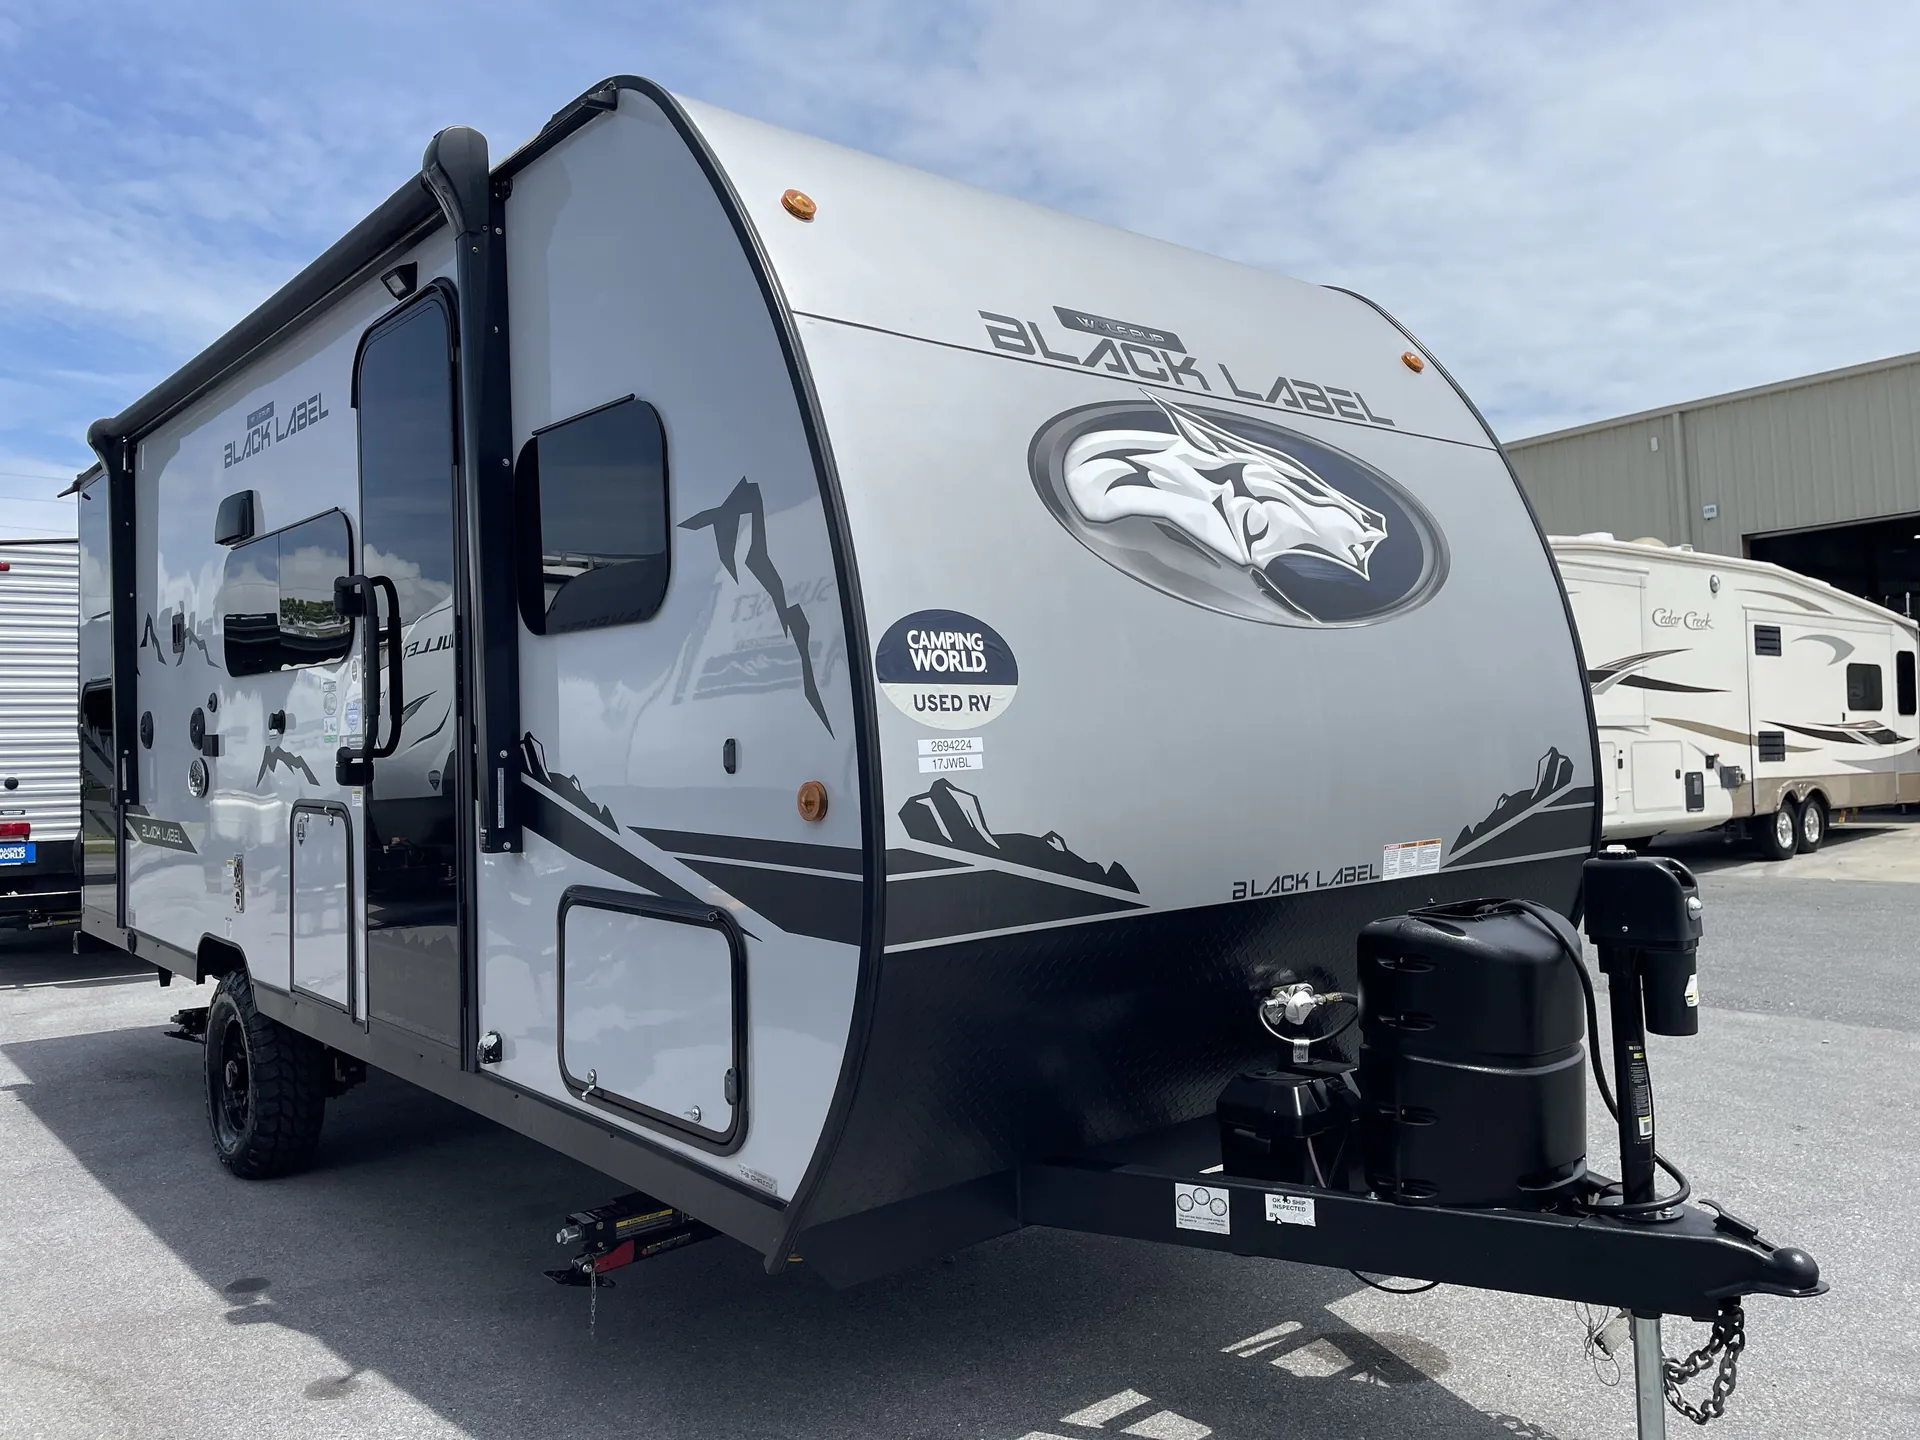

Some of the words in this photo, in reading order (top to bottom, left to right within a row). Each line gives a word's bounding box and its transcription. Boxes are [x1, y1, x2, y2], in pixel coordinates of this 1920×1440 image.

[1129, 327, 1165, 343] PUP
[977, 309, 1211, 392] BLACK
[1217, 362, 1396, 427] LABEL
[224, 420, 271, 470] BLACK
[275, 391, 329, 444] LABEL
[1651, 607, 1683, 628] Cedar
[1683, 610, 1715, 631] Creek
[906, 629, 985, 651] CAMPING
[912, 693, 964, 712] USED
[968, 694, 992, 712] RV
[930, 738, 973, 753] 2694224
[932, 756, 972, 770] 17JWBL
[141, 823, 161, 840] BLACK
[162, 827, 183, 844] LABEL
[1232, 872, 1310, 901] BLACK
[1316, 863, 1381, 888] LABEL
[1272, 1203, 1307, 1213] INSPECTED
